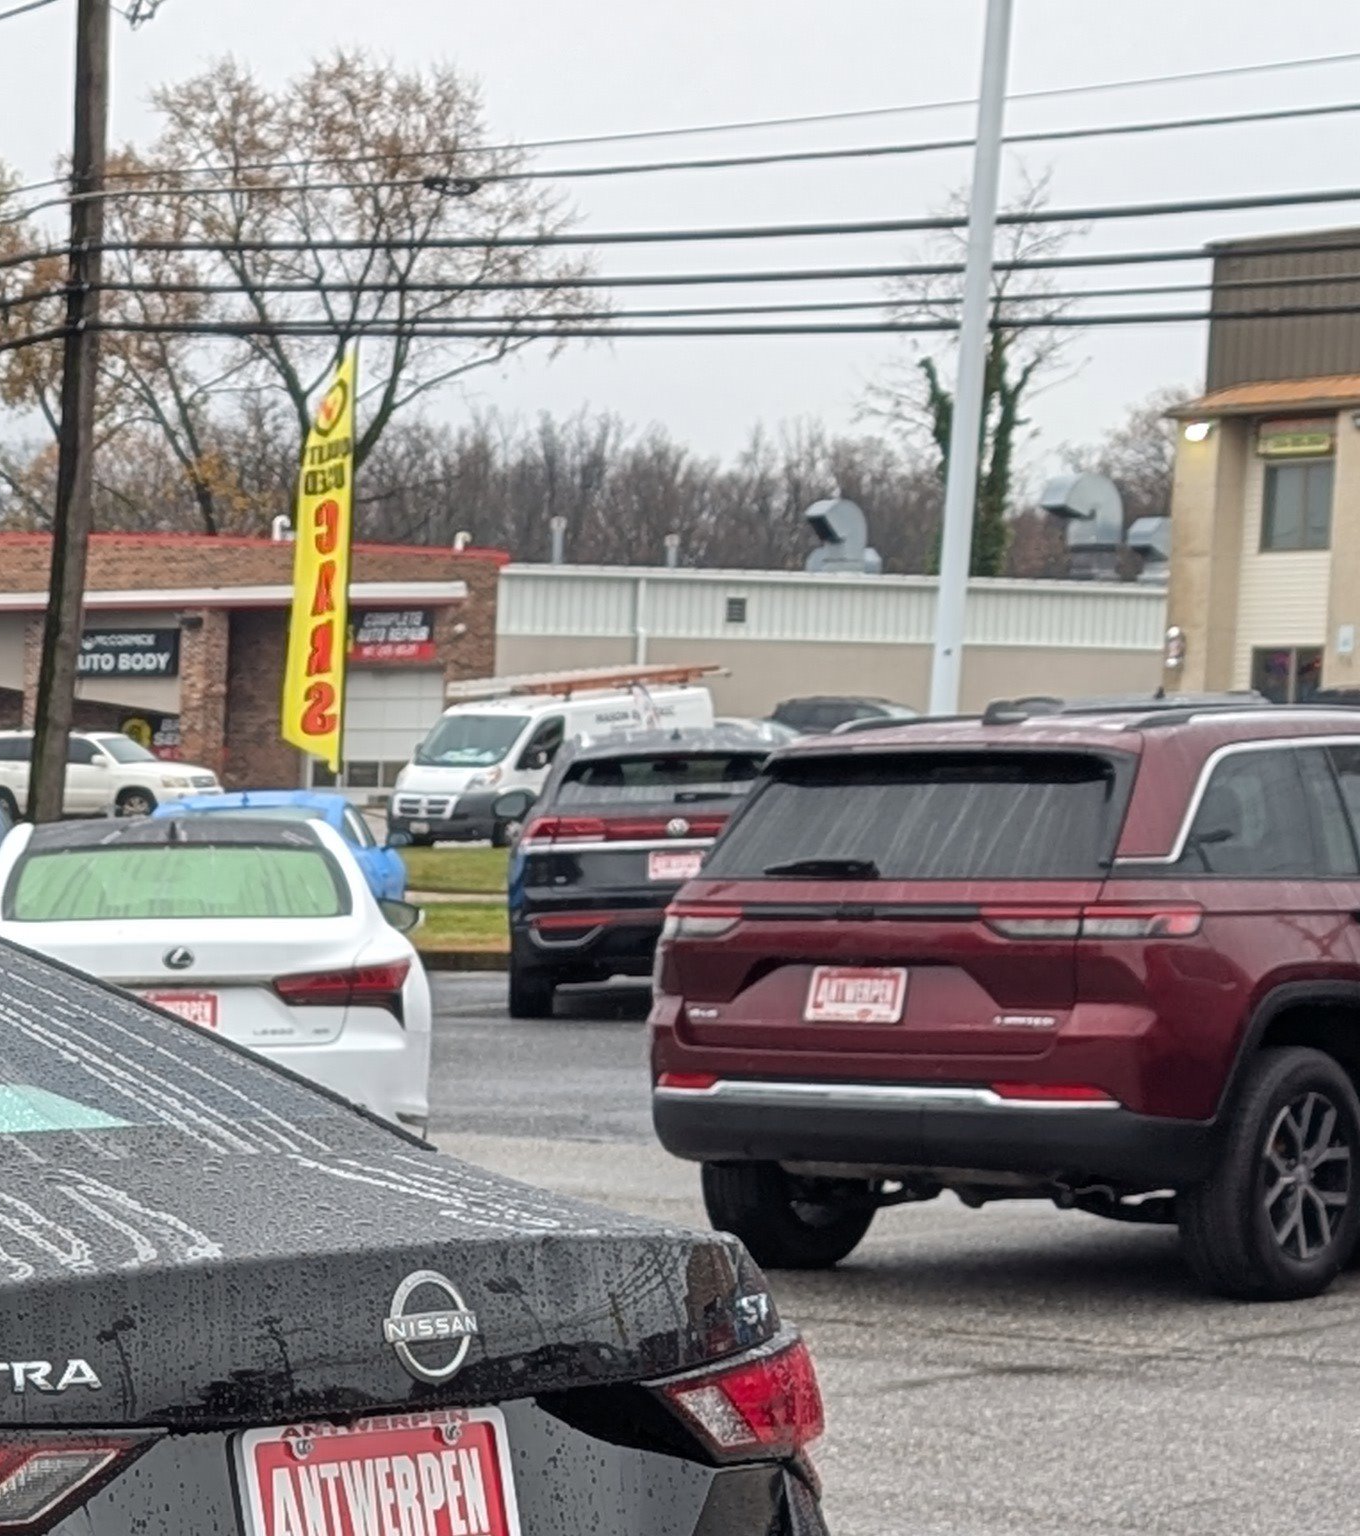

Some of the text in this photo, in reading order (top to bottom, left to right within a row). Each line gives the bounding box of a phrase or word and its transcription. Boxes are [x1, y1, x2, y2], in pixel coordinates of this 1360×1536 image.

[77, 653, 171, 671] UTO BODY
[387, 1315, 478, 1339] NISSAN
